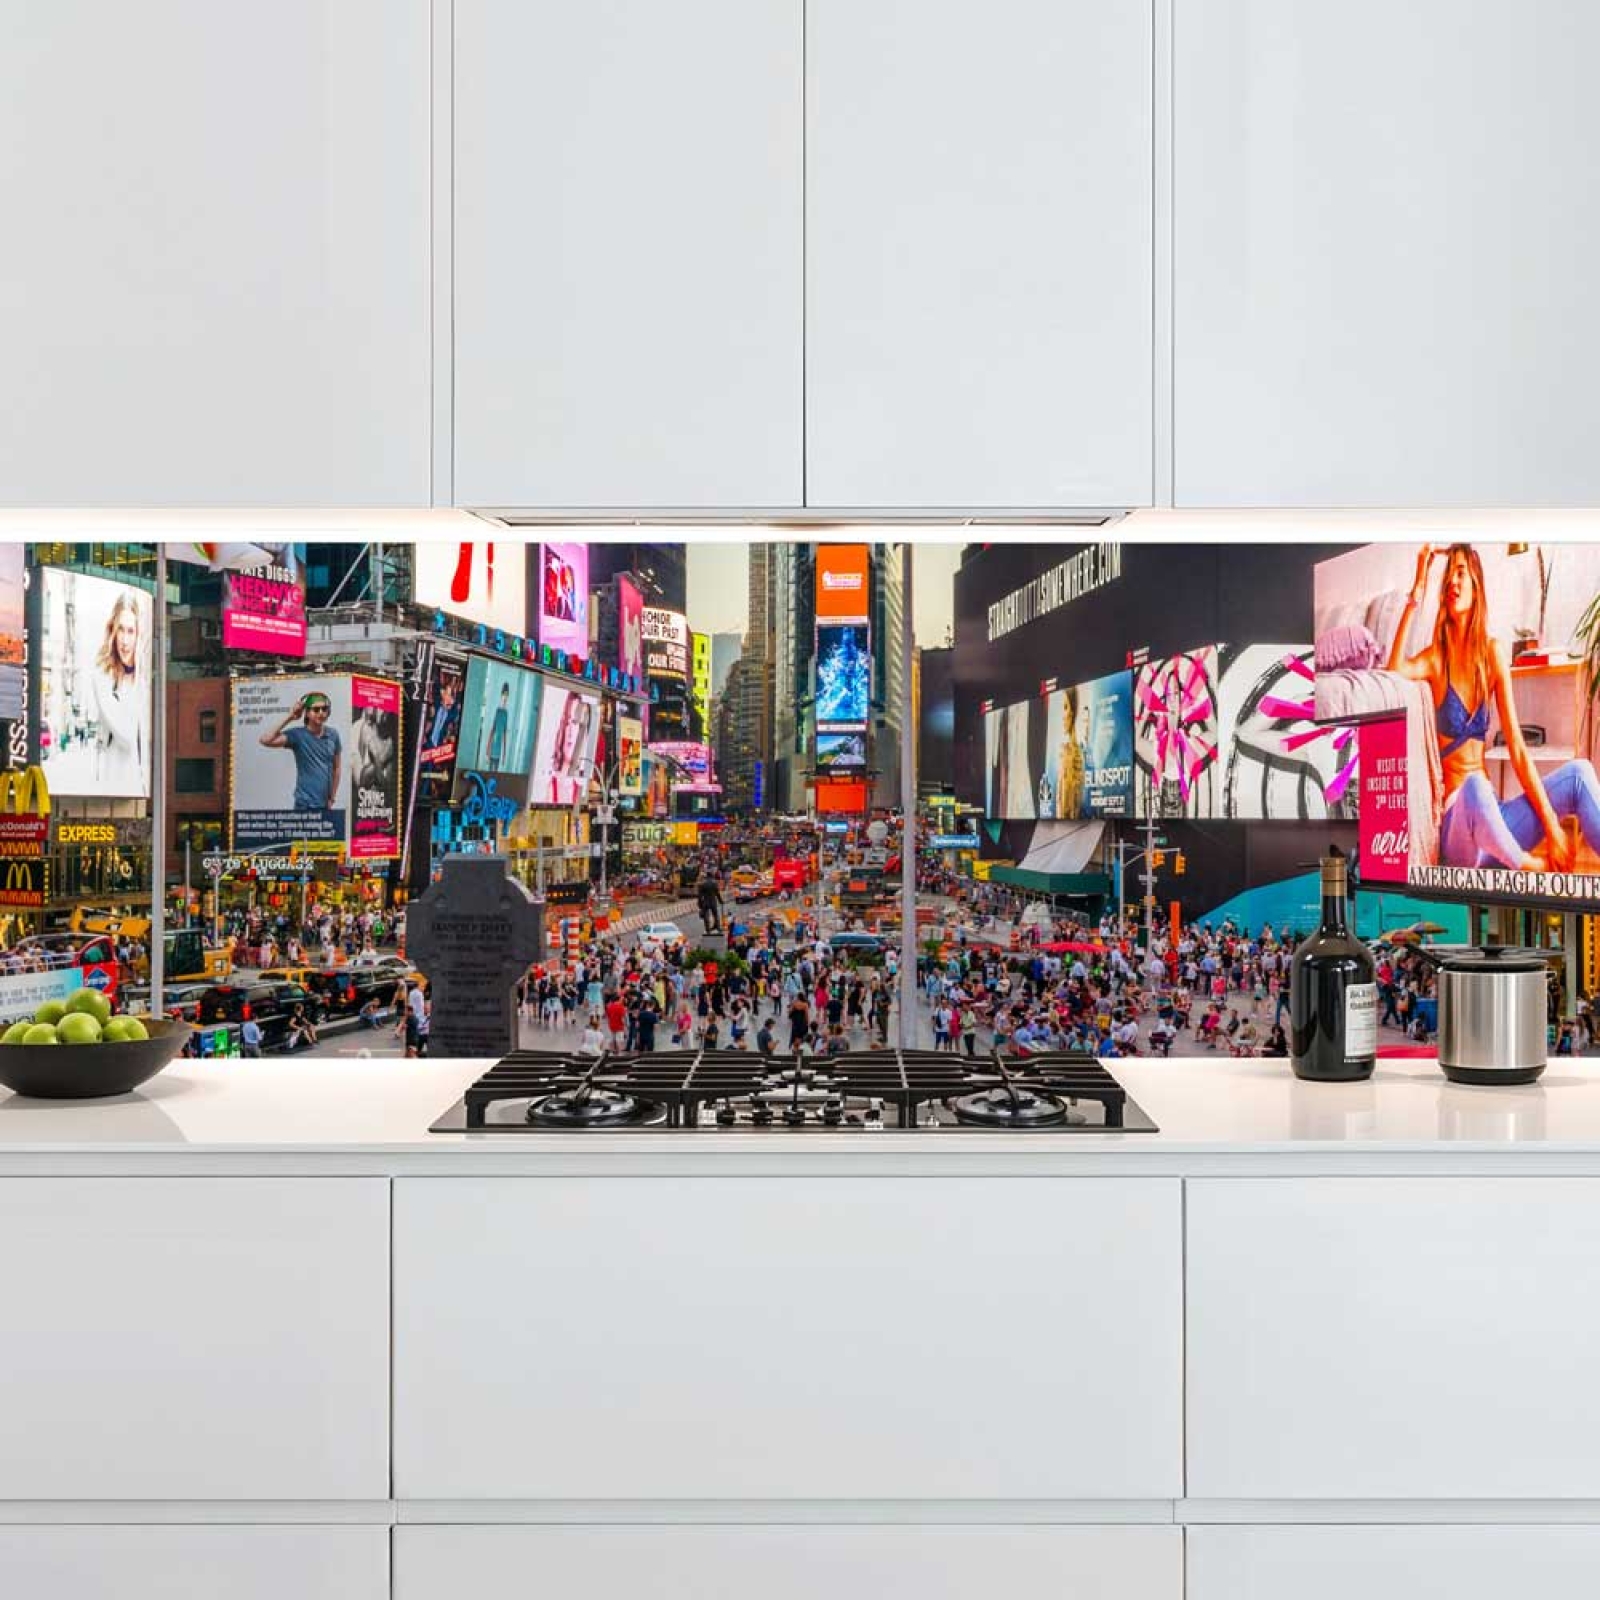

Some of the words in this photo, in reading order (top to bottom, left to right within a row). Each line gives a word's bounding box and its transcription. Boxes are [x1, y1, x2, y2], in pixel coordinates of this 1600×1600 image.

[1376, 758, 1396, 773] VISIT
[1367, 776, 1391, 792] INSIDE
[1393, 776, 1403, 791] ON
[58, 826, 116, 842] EXPRESS
[1409, 865, 1487, 892] AMERICAN
[1492, 870, 1547, 896] EAGLE
